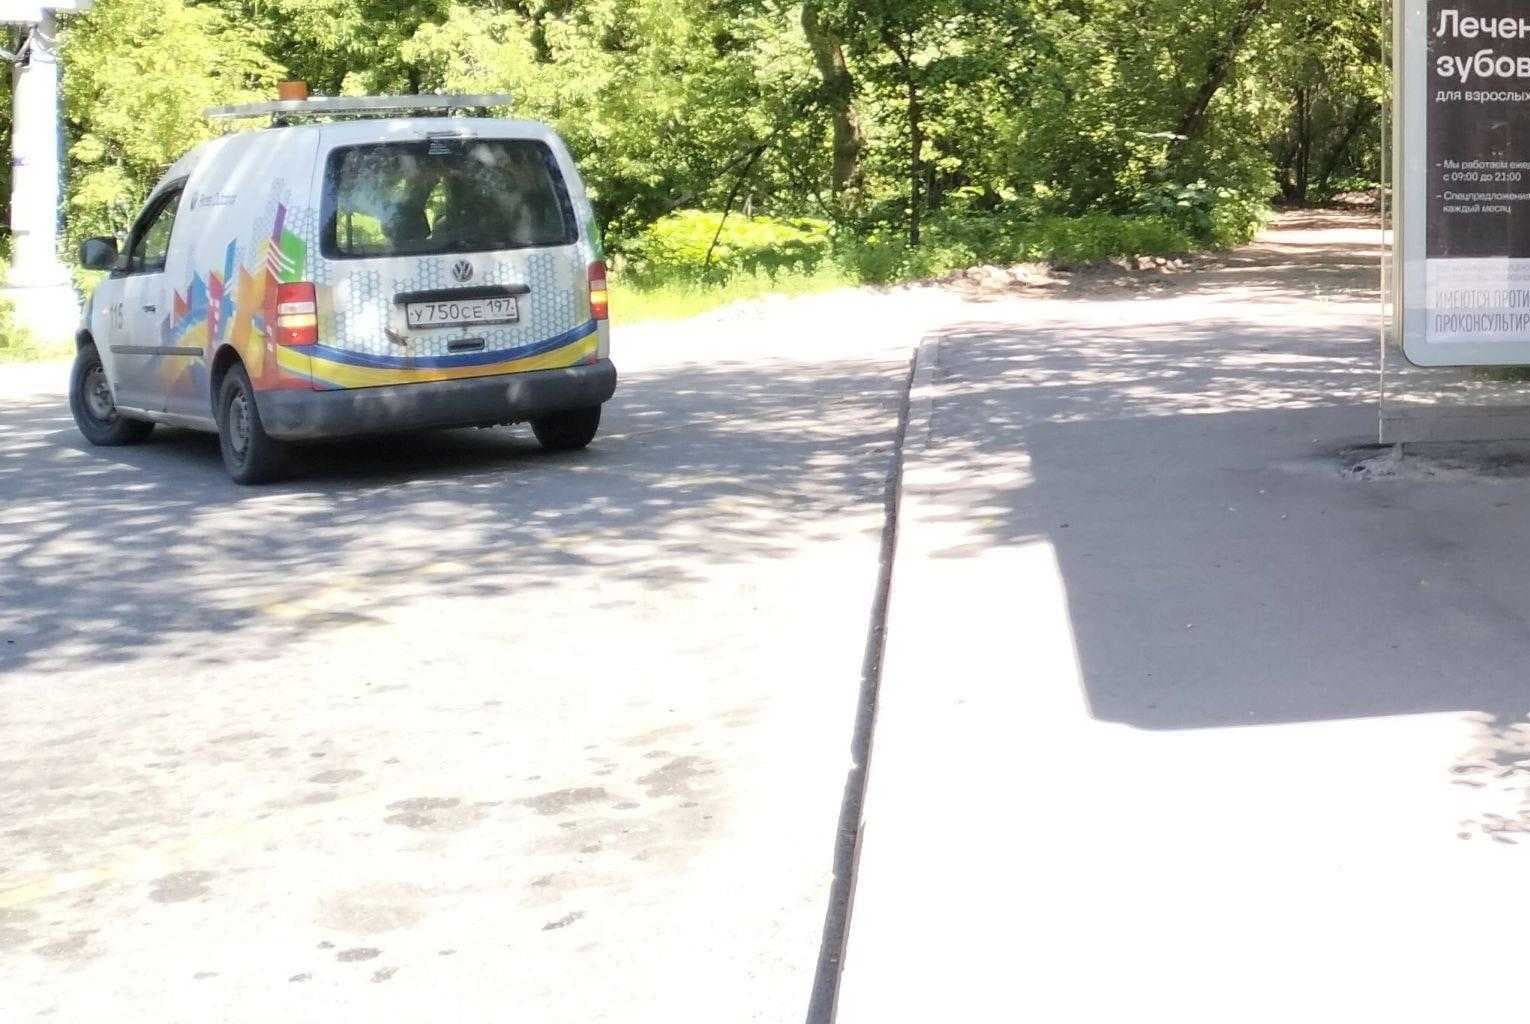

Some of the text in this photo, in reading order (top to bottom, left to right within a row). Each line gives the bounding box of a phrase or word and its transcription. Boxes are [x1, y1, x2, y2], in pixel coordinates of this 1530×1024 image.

[1435, 90, 1462, 102] для
[1443, 160, 1460, 170] Мы
[1461, 159, 1508, 171] работаем
[1443, 172, 1521, 182] с 09:00 до 21:00
[1443, 190, 1530, 202] Спецпредложения
[1443, 203, 1512, 214] каждый месяц
[1436, 289, 1490, 308] ИМЕЮТСЯ
[486, 299, 511, 312] 197
